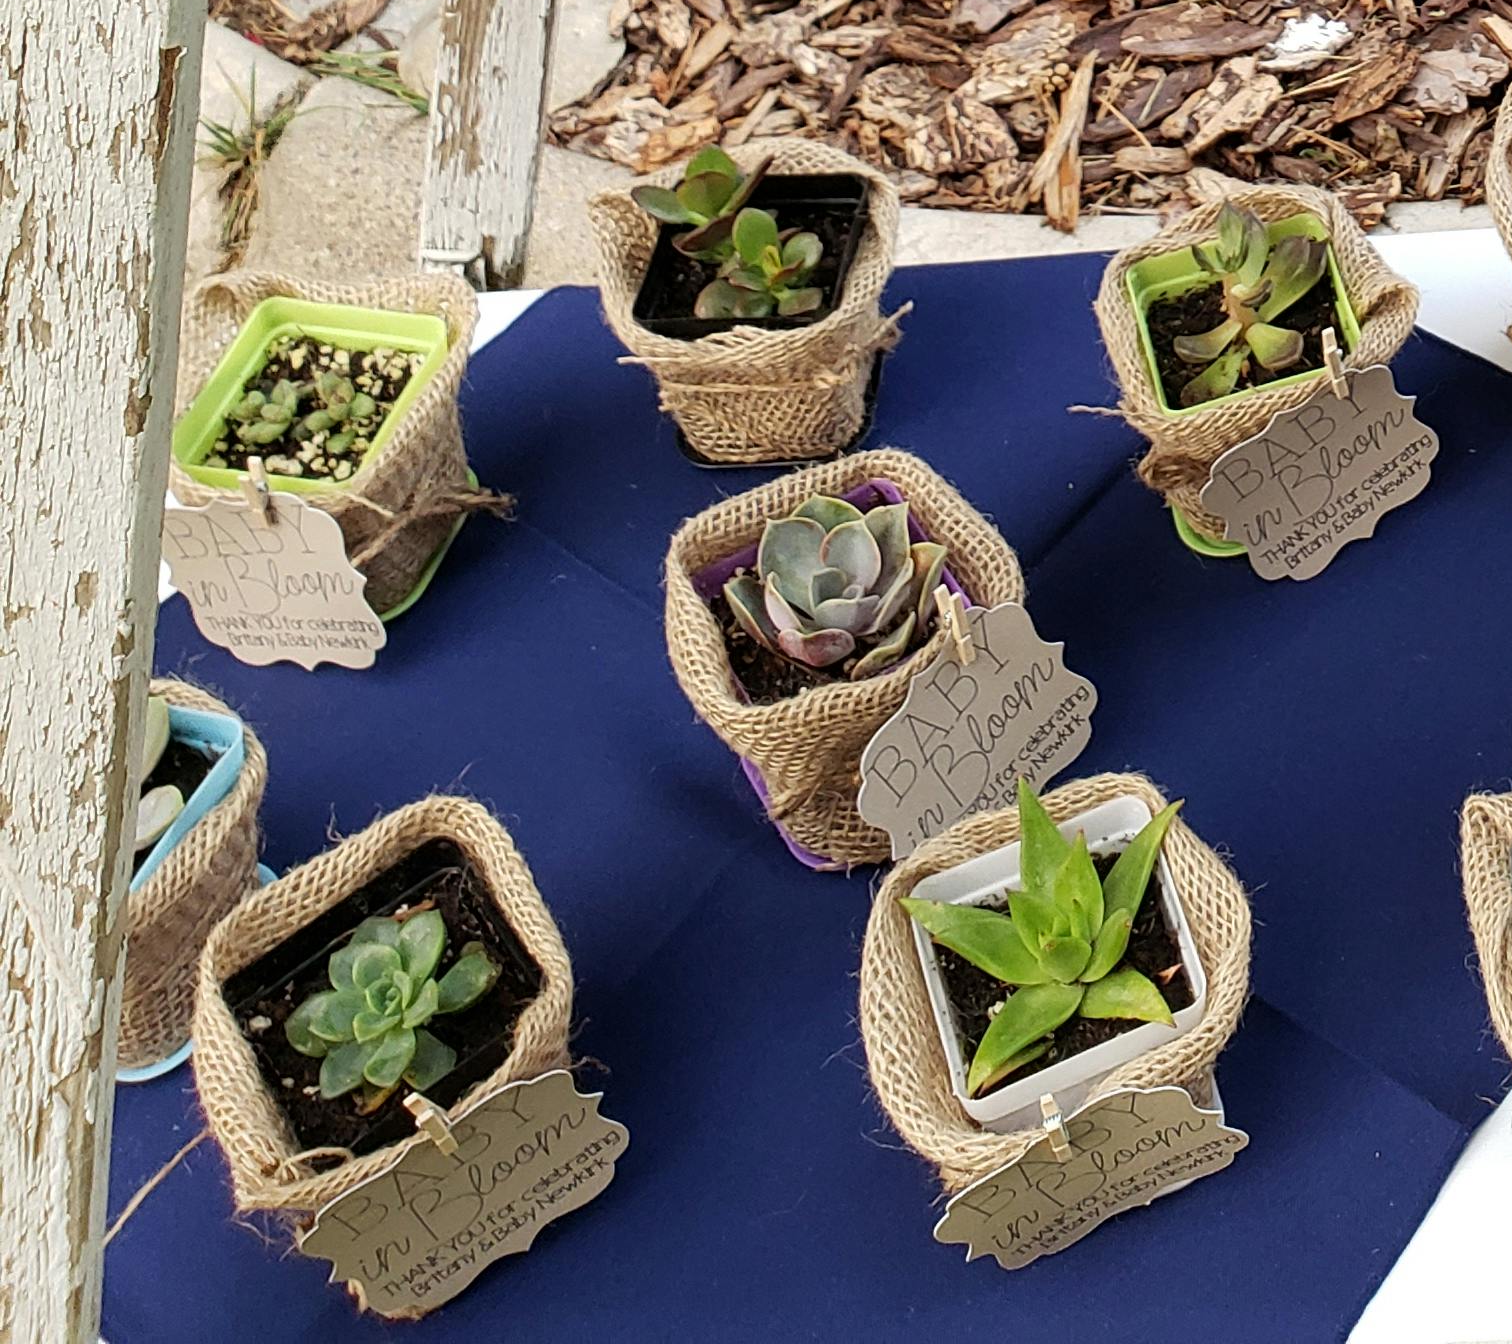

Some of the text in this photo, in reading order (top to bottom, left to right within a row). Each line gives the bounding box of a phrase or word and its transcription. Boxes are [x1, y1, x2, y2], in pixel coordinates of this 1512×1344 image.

[1214, 372, 1367, 503] BABY
[1243, 409, 1404, 546] in Bloom
[1259, 434, 1433, 564] THANK YOU for celebrating
[164, 505, 317, 558] BABY
[1284, 458, 1427, 570] Britany & Baby Newkirk
[189, 554, 353, 616] in Bloom
[865, 611, 1010, 808] BABY
[926, 657, 1054, 817] Bloom
[996, 760, 1017, 786] for
[1018, 685, 1090, 761] celebrating
[1035, 713, 1085, 771] Newkirk
[331, 1085, 534, 1241] BABY
[360, 1108, 585, 1281] in Bloom
[992, 1118, 1205, 1249] in Bloom
